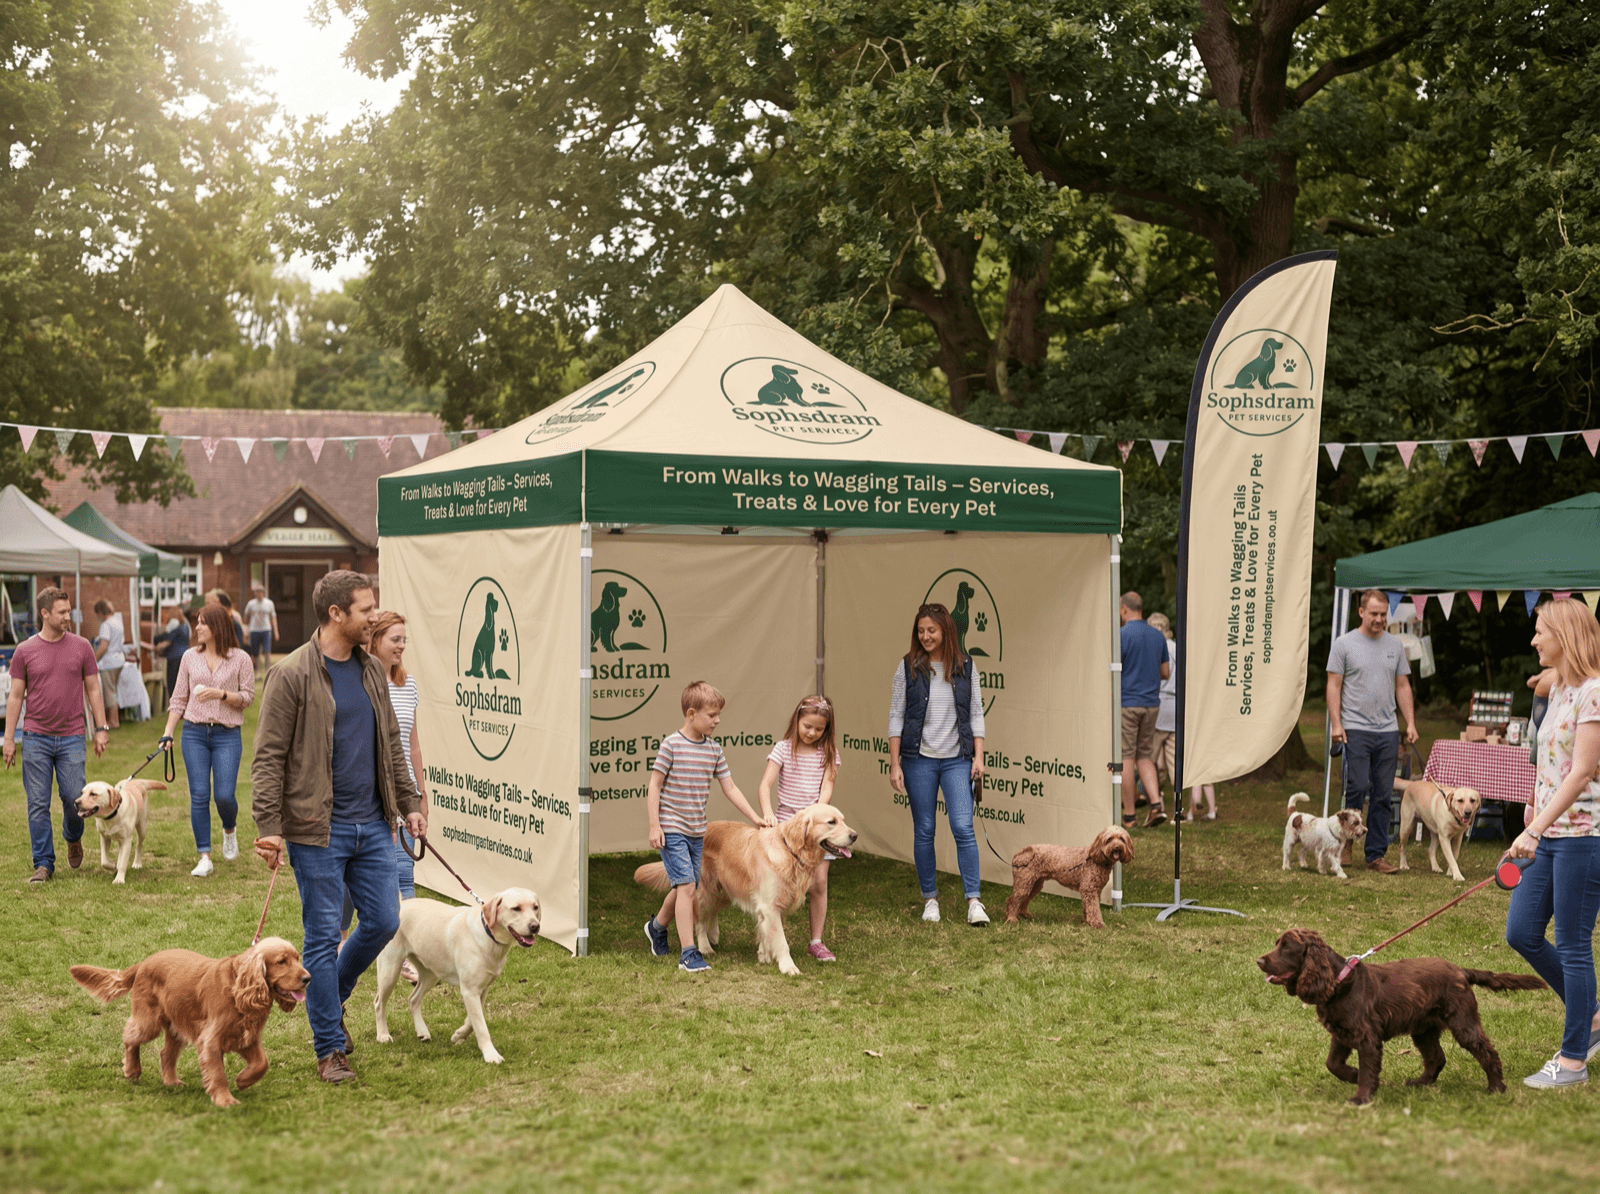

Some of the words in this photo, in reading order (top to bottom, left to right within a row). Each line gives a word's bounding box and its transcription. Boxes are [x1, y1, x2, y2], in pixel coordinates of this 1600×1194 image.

[1207, 392, 1315, 412] Sophsdram
[732, 407, 883, 427] Sophsdram
[800, 427, 860, 435] SERVICES
[1249, 414, 1292, 422] SERVICES
[1250, 453, 1263, 477] Pet
[401, 487, 420, 501] From
[421, 483, 442, 499] Walks
[443, 483, 451, 497] to
[453, 478, 486, 499] Wagging
[487, 475, 505, 492] Tails
[514, 470, 553, 489] Services,
[663, 466, 716, 484] From
[722, 468, 782, 486] Walks
[788, 471, 809, 487] to
[814, 471, 898, 494] Wagging
[903, 474, 947, 492] Tails
[969, 477, 1054, 499] Services,
[424, 505, 447, 520] Treats
[448, 502, 455, 518] &
[456, 502, 474, 517] Love
[475, 499, 487, 516] for
[488, 498, 511, 518] Every
[513, 496, 527, 512] Pet
[732, 492, 797, 510] Treats
[803, 494, 817, 511] &
[823, 495, 868, 512] Love
[874, 496, 901, 513] for
[907, 497, 960, 519] Every
[965, 500, 997, 516] Pet
[1233, 484, 1247, 518] Tails
[1248, 481, 1264, 521] Every
[1247, 525, 1259, 546] for
[1230, 521, 1247, 583] Wagging
[1245, 550, 1258, 582] Love
[1230, 586, 1241, 601] to
[1244, 587, 1256, 598] &
[1227, 604, 1240, 647] Walks
[1242, 601, 1256, 647] Treats
[1226, 651, 1238, 686] From
[1240, 651, 1255, 715] Services,
[456, 682, 522, 716] Sophsdram
[592, 688, 645, 699] SERVICES
[469, 719, 480, 731] PET
[481, 721, 509, 736] SERVICES
[615, 758, 641, 773] for
[843, 734, 870, 751] From
[983, 751, 1009, 769] Tails
[1024, 755, 1086, 783] Services,
[428, 765, 453, 786] Walks
[455, 772, 464, 789] to
[465, 773, 501, 803] Wagging
[502, 782, 522, 804] Tails
[531, 789, 572, 820] Services,
[983, 774, 1018, 797] Every
[1022, 778, 1044, 797] Pet
[432, 789, 458, 811] Treats
[460, 796, 466, 814] &
[468, 798, 488, 819] Love
[489, 804, 502, 823] for
[503, 807, 527, 834] Every
[529, 813, 544, 835] Pet
